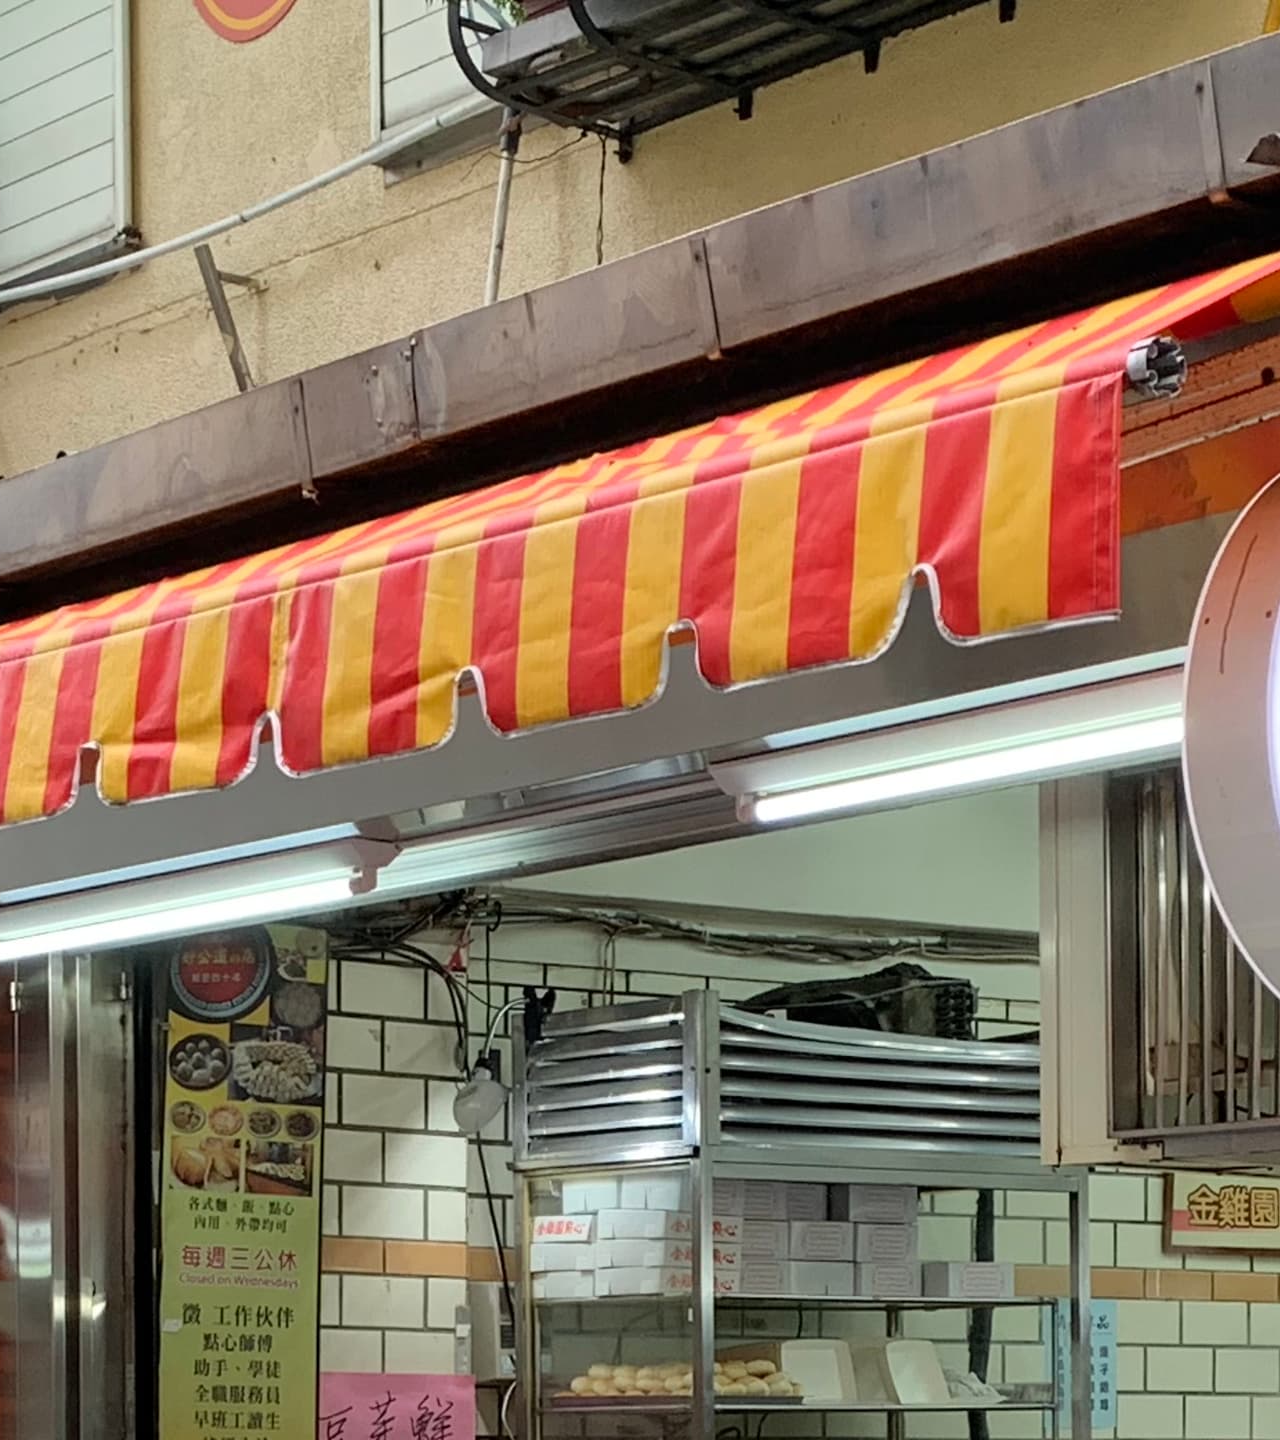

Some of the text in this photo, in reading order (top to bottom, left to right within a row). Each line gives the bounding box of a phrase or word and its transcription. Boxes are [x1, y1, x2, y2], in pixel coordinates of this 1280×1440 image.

[1186, 1183, 1280, 1229] 金雞園
[181, 1245, 297, 1272] 每週三公休
[203, 1332, 273, 1353] 點心師傅
[195, 1384, 281, 1405] 全職服務員
[194, 1410, 281, 1431] 早班工讀生
